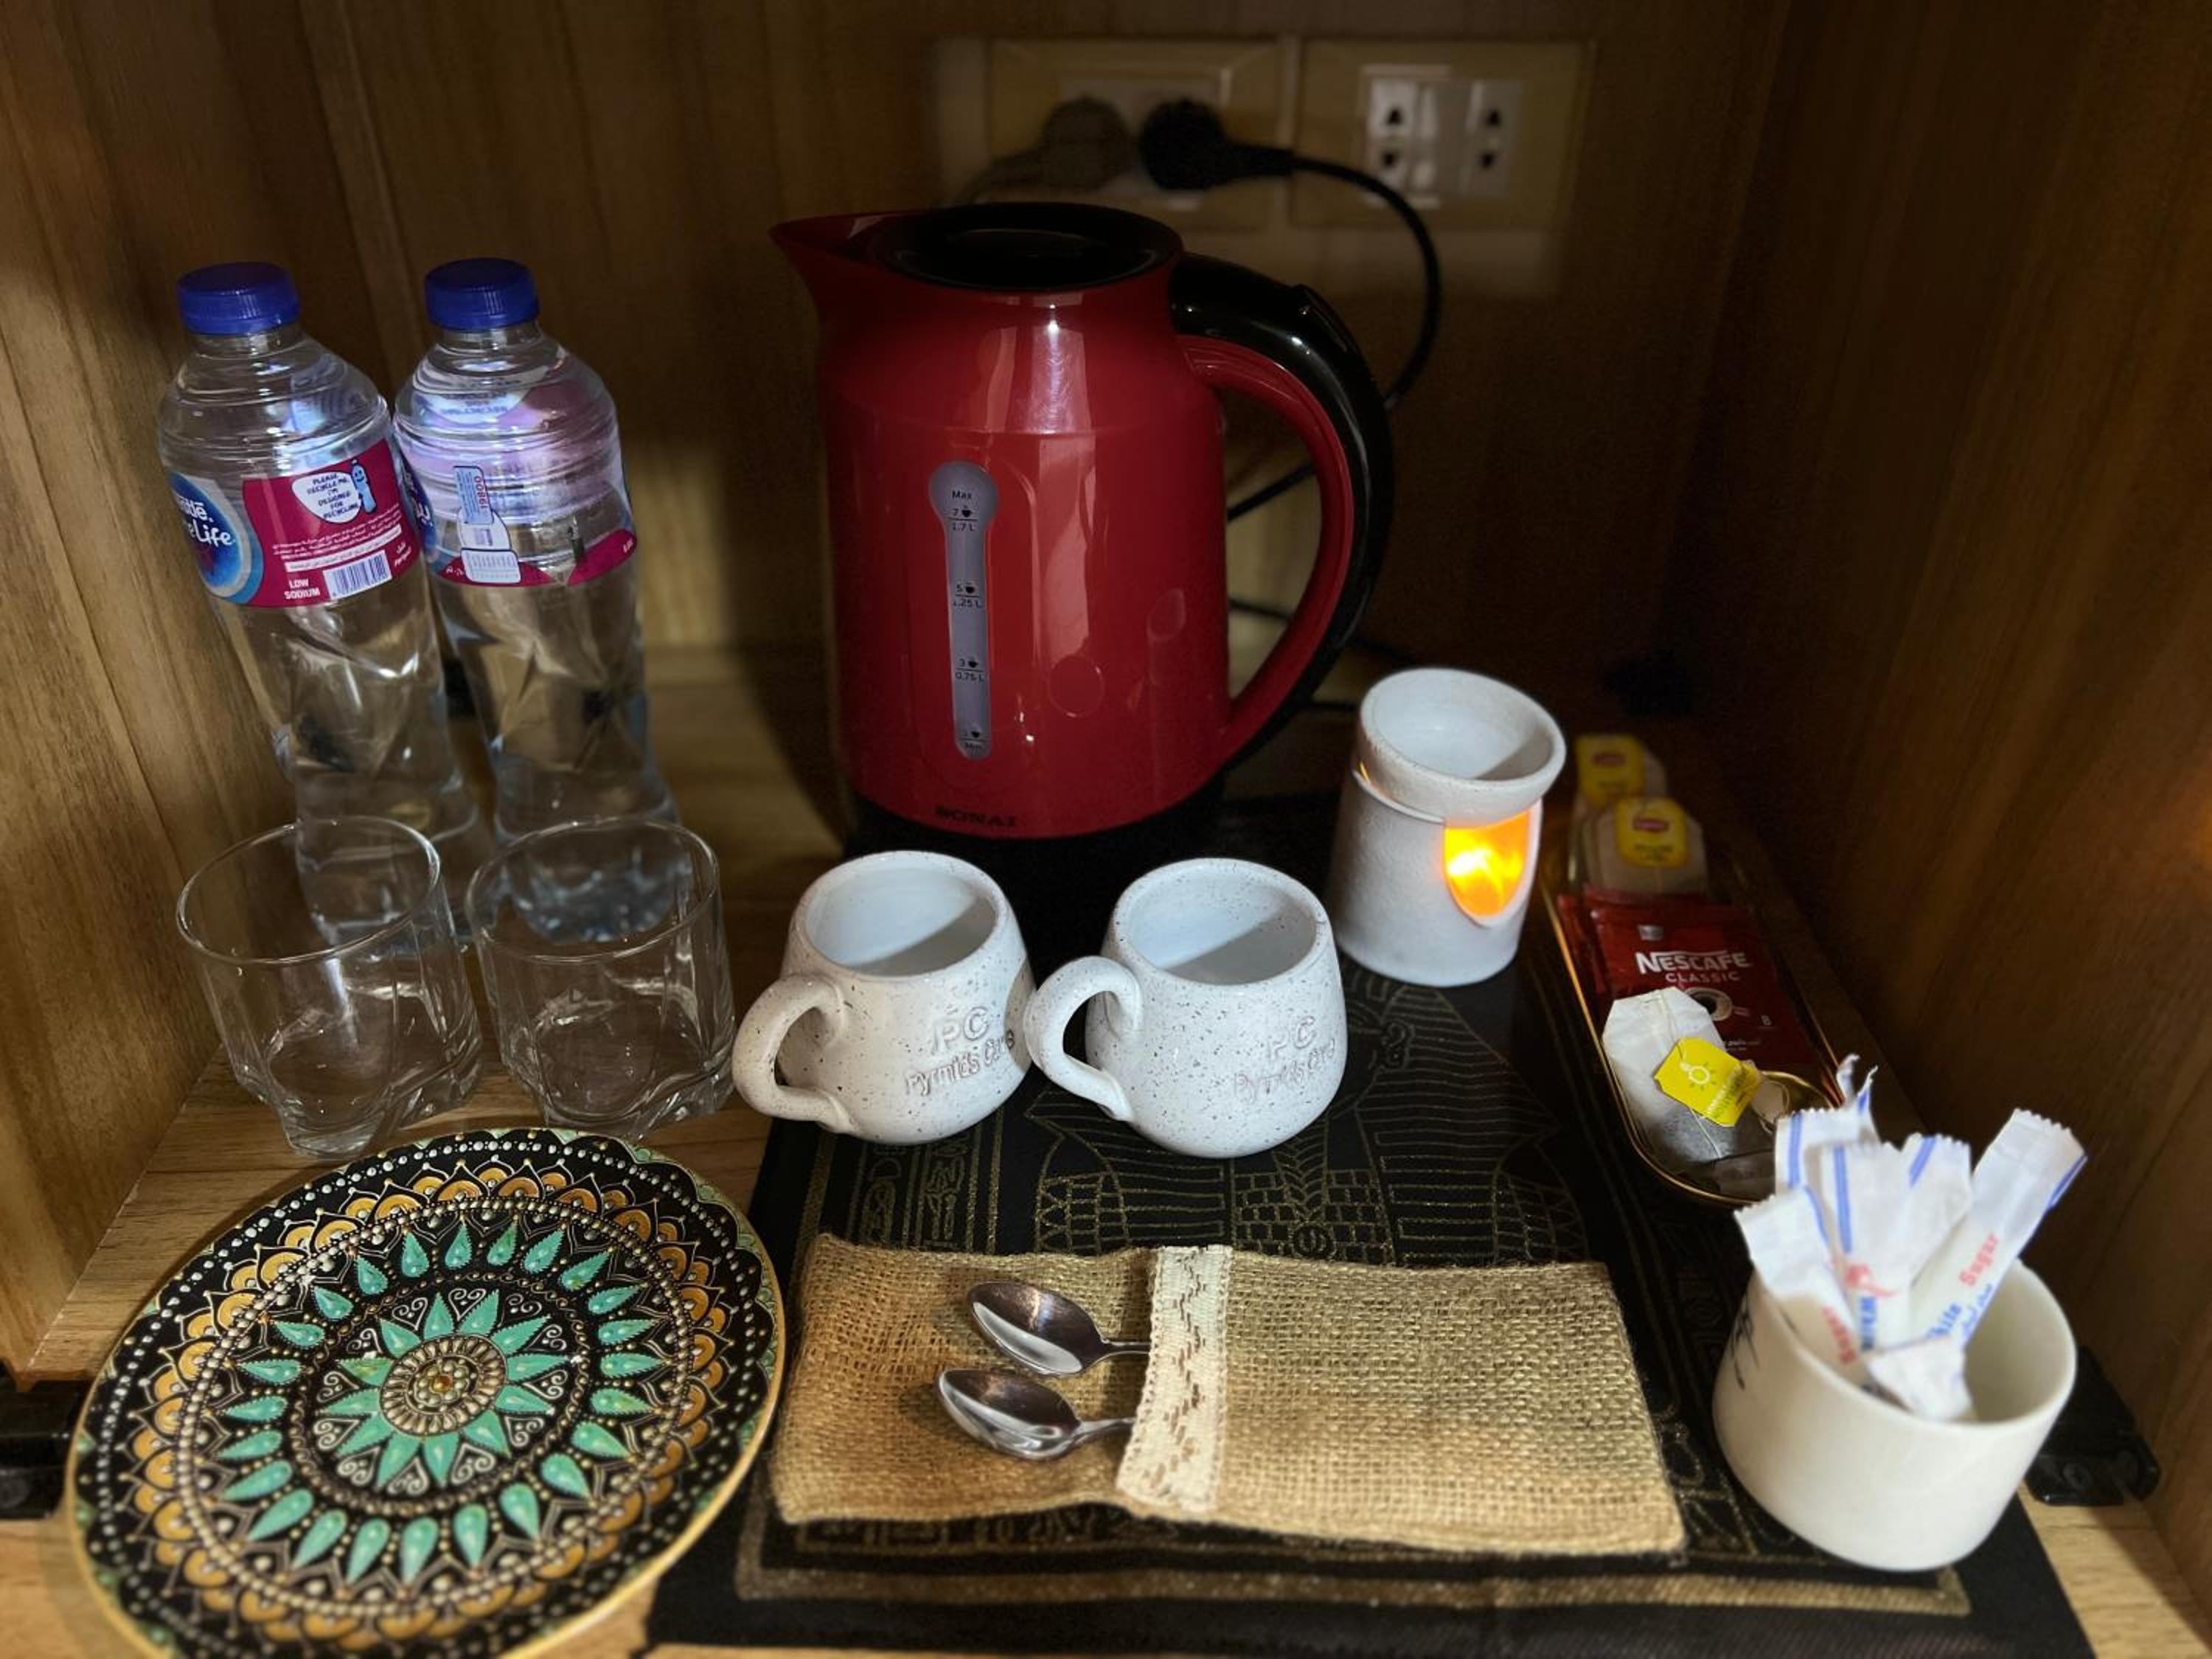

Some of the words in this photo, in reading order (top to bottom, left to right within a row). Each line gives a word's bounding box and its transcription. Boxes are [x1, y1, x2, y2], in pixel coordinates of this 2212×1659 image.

[952, 490, 973, 500] Max
[289, 578, 310, 588] LOW
[285, 588, 321, 600] SODIUM
[1665, 971, 1741, 984] CLASSIC
[1958, 1233, 1997, 1287] Sugar
